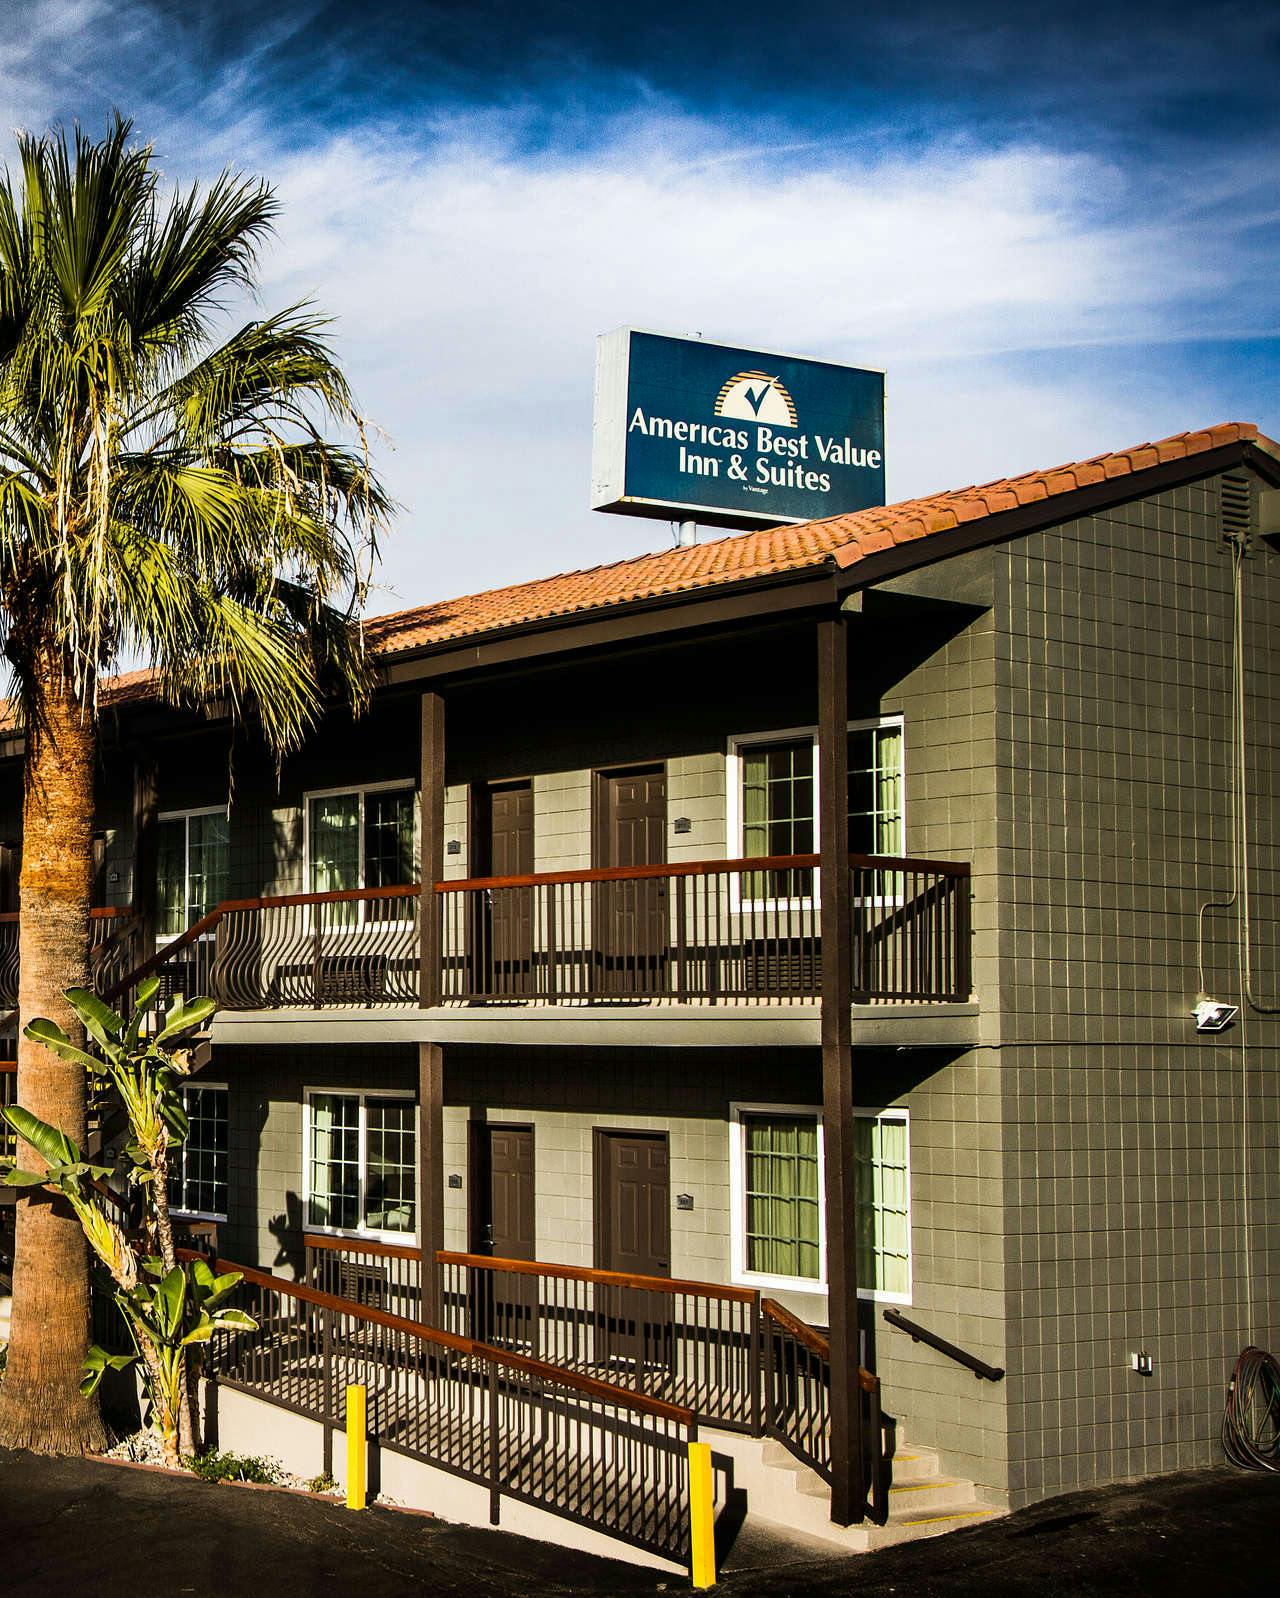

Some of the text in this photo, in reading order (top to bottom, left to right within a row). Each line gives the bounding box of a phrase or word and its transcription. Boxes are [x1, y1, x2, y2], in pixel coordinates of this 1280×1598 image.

[628, 407, 882, 469] Americas Best Value
[679, 446, 831, 493] Inn & Suites
